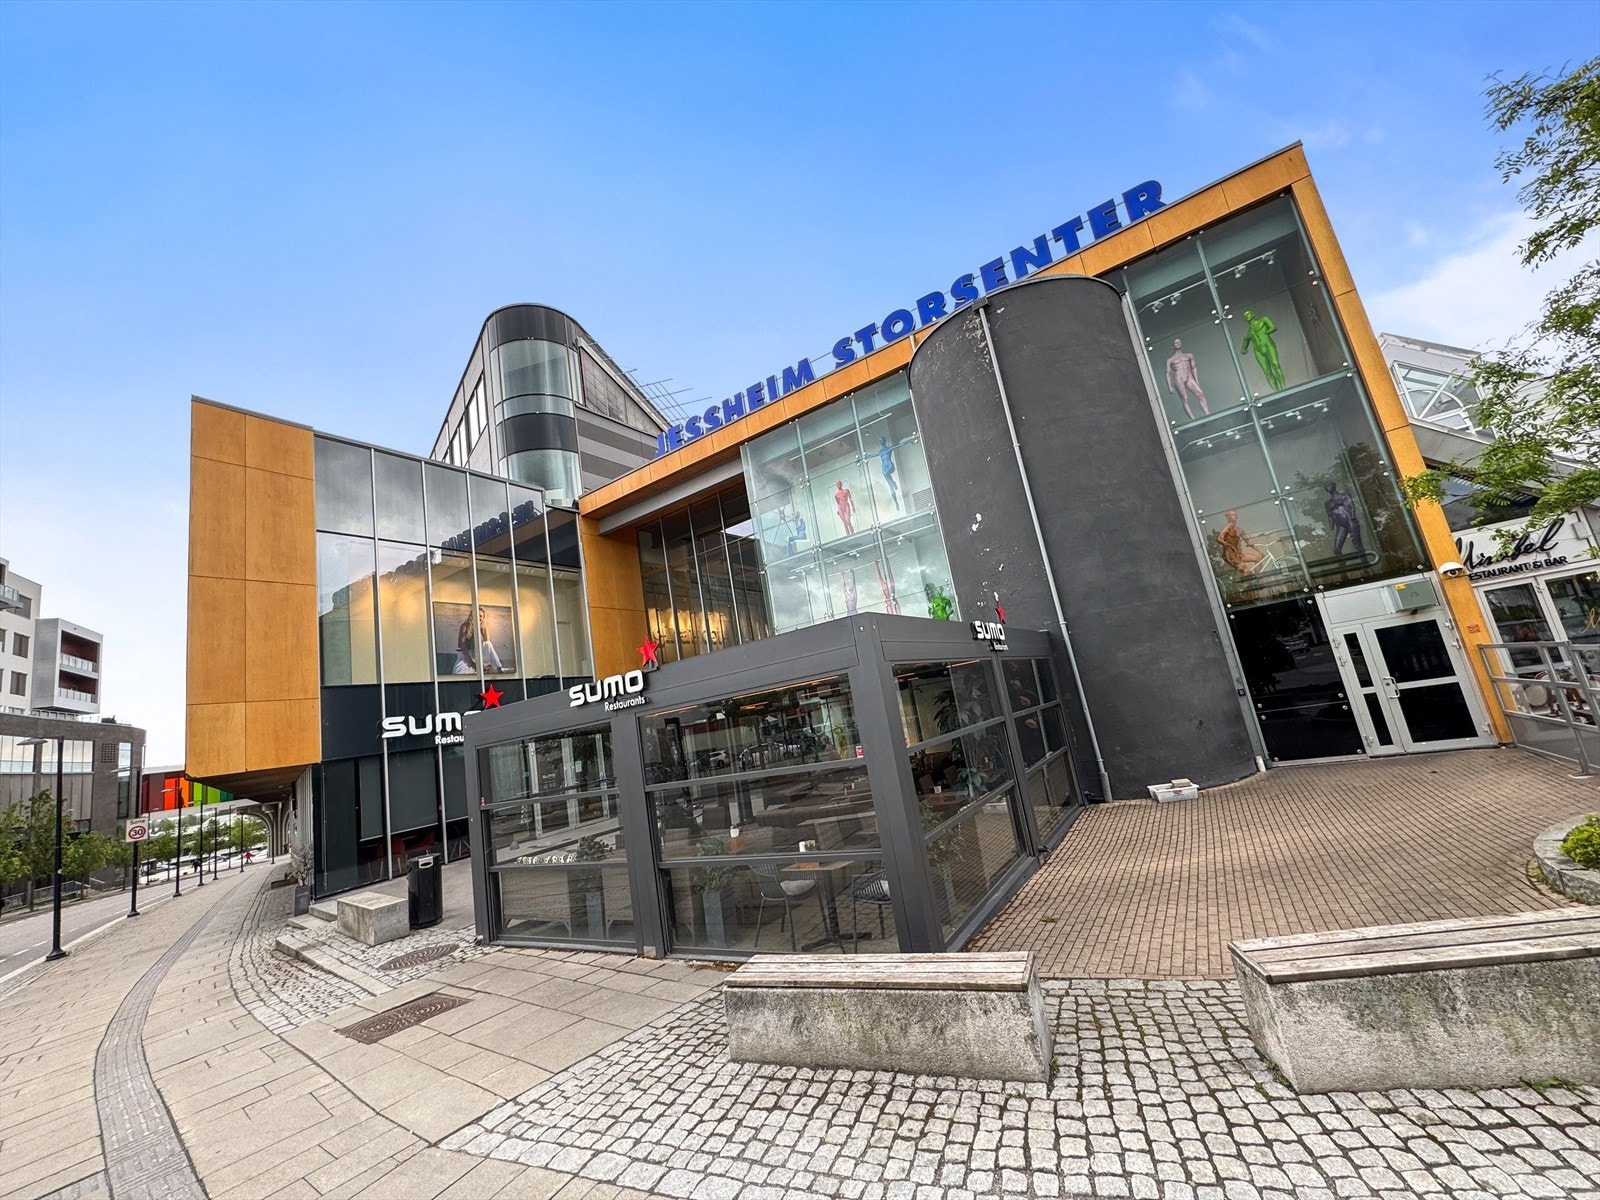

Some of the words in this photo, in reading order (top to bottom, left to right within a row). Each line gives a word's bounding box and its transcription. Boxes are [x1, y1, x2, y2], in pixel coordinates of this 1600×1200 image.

[655, 358, 815, 459] JESSHEIM
[832, 179, 1168, 368] STORSENTER
[1469, 563, 1529, 580] ESTAURANT
[1532, 561, 1544, 570] &
[1545, 556, 1568, 567] BAR
[974, 621, 1005, 640] SUMO
[569, 669, 644, 707] SUMO
[604, 695, 645, 712] Restaurants
[381, 710, 482, 738] SUM
[435, 734, 464, 745] Restau
